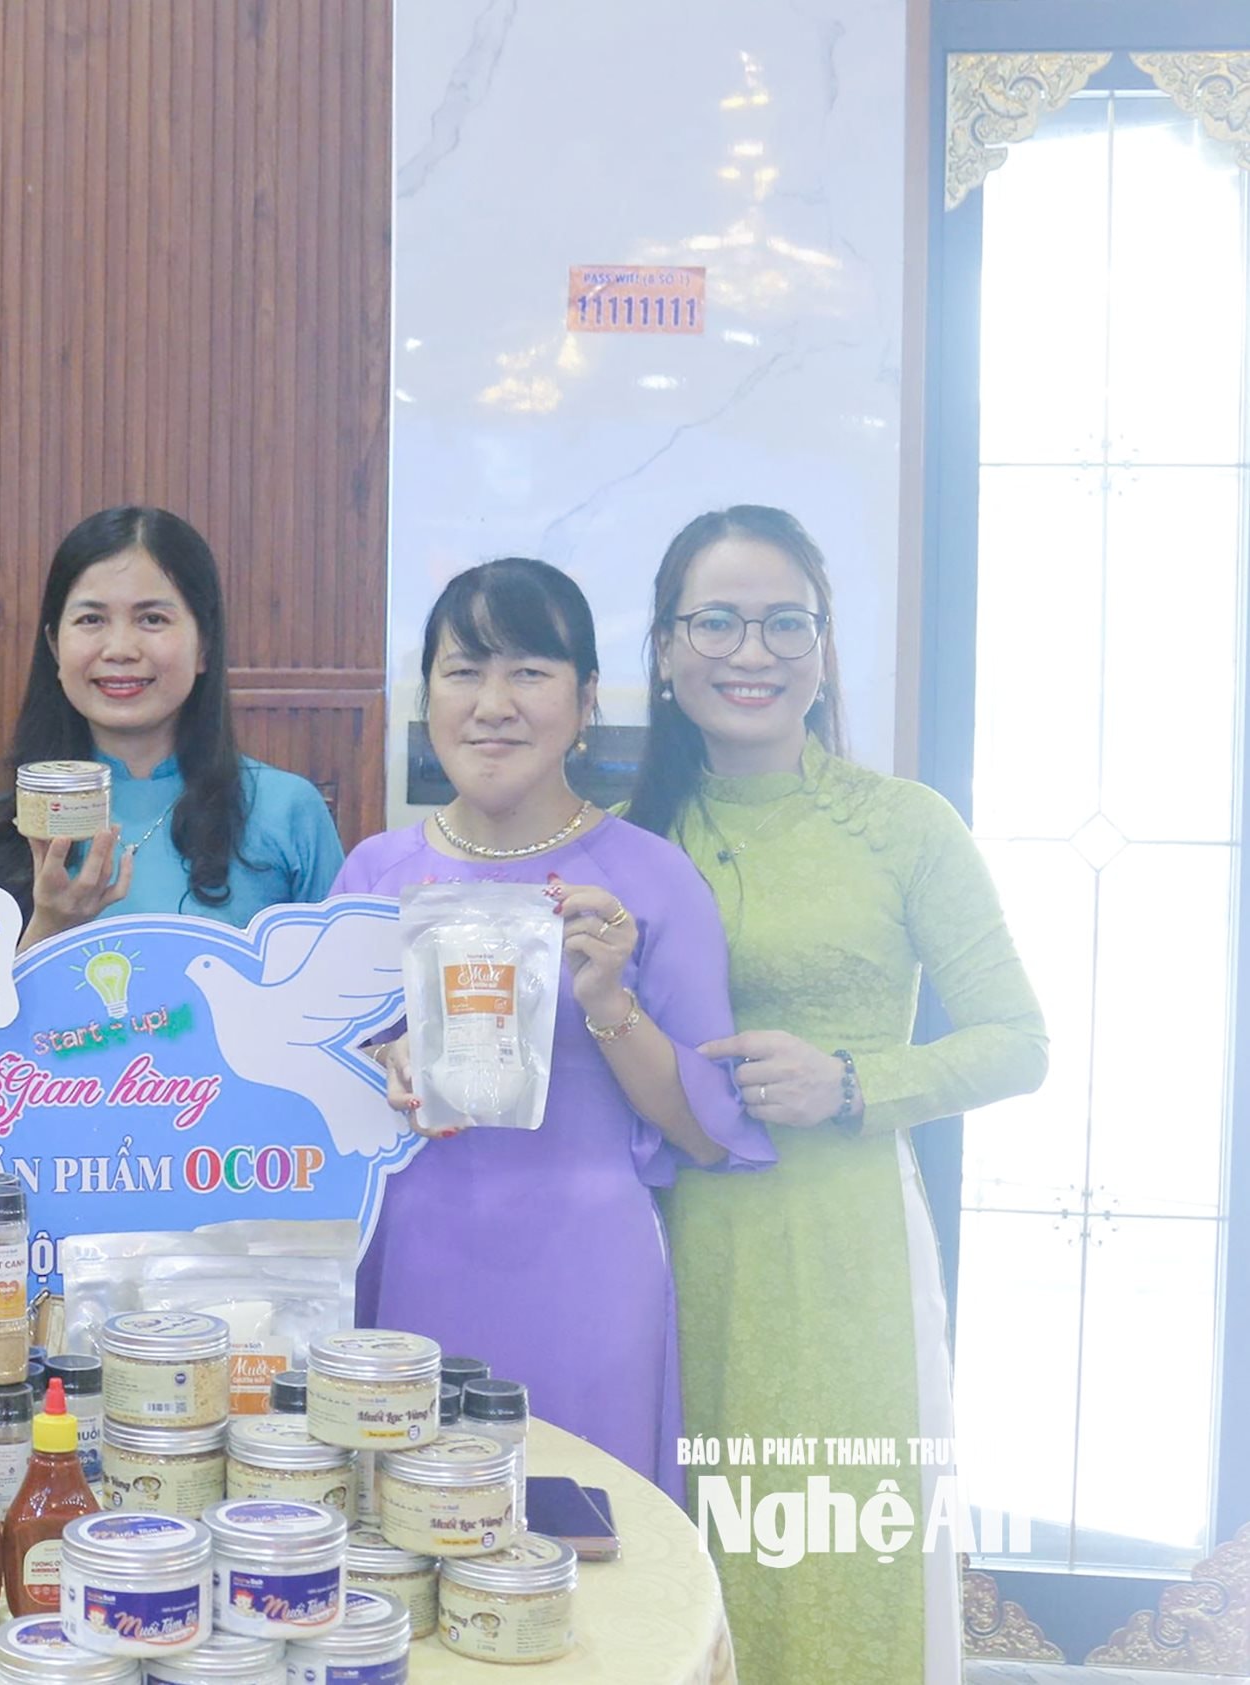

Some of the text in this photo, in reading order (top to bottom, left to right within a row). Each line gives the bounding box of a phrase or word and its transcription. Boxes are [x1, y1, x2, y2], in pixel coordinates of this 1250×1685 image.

[584, 273, 611, 284] PASS
[577, 295, 695, 326] 11111111
[33, 1020, 103, 1056] Start
[109, 1054, 221, 1131] hàng
[55, 1136, 173, 1195] PHẨM
[184, 1146, 326, 1193] OCOP
